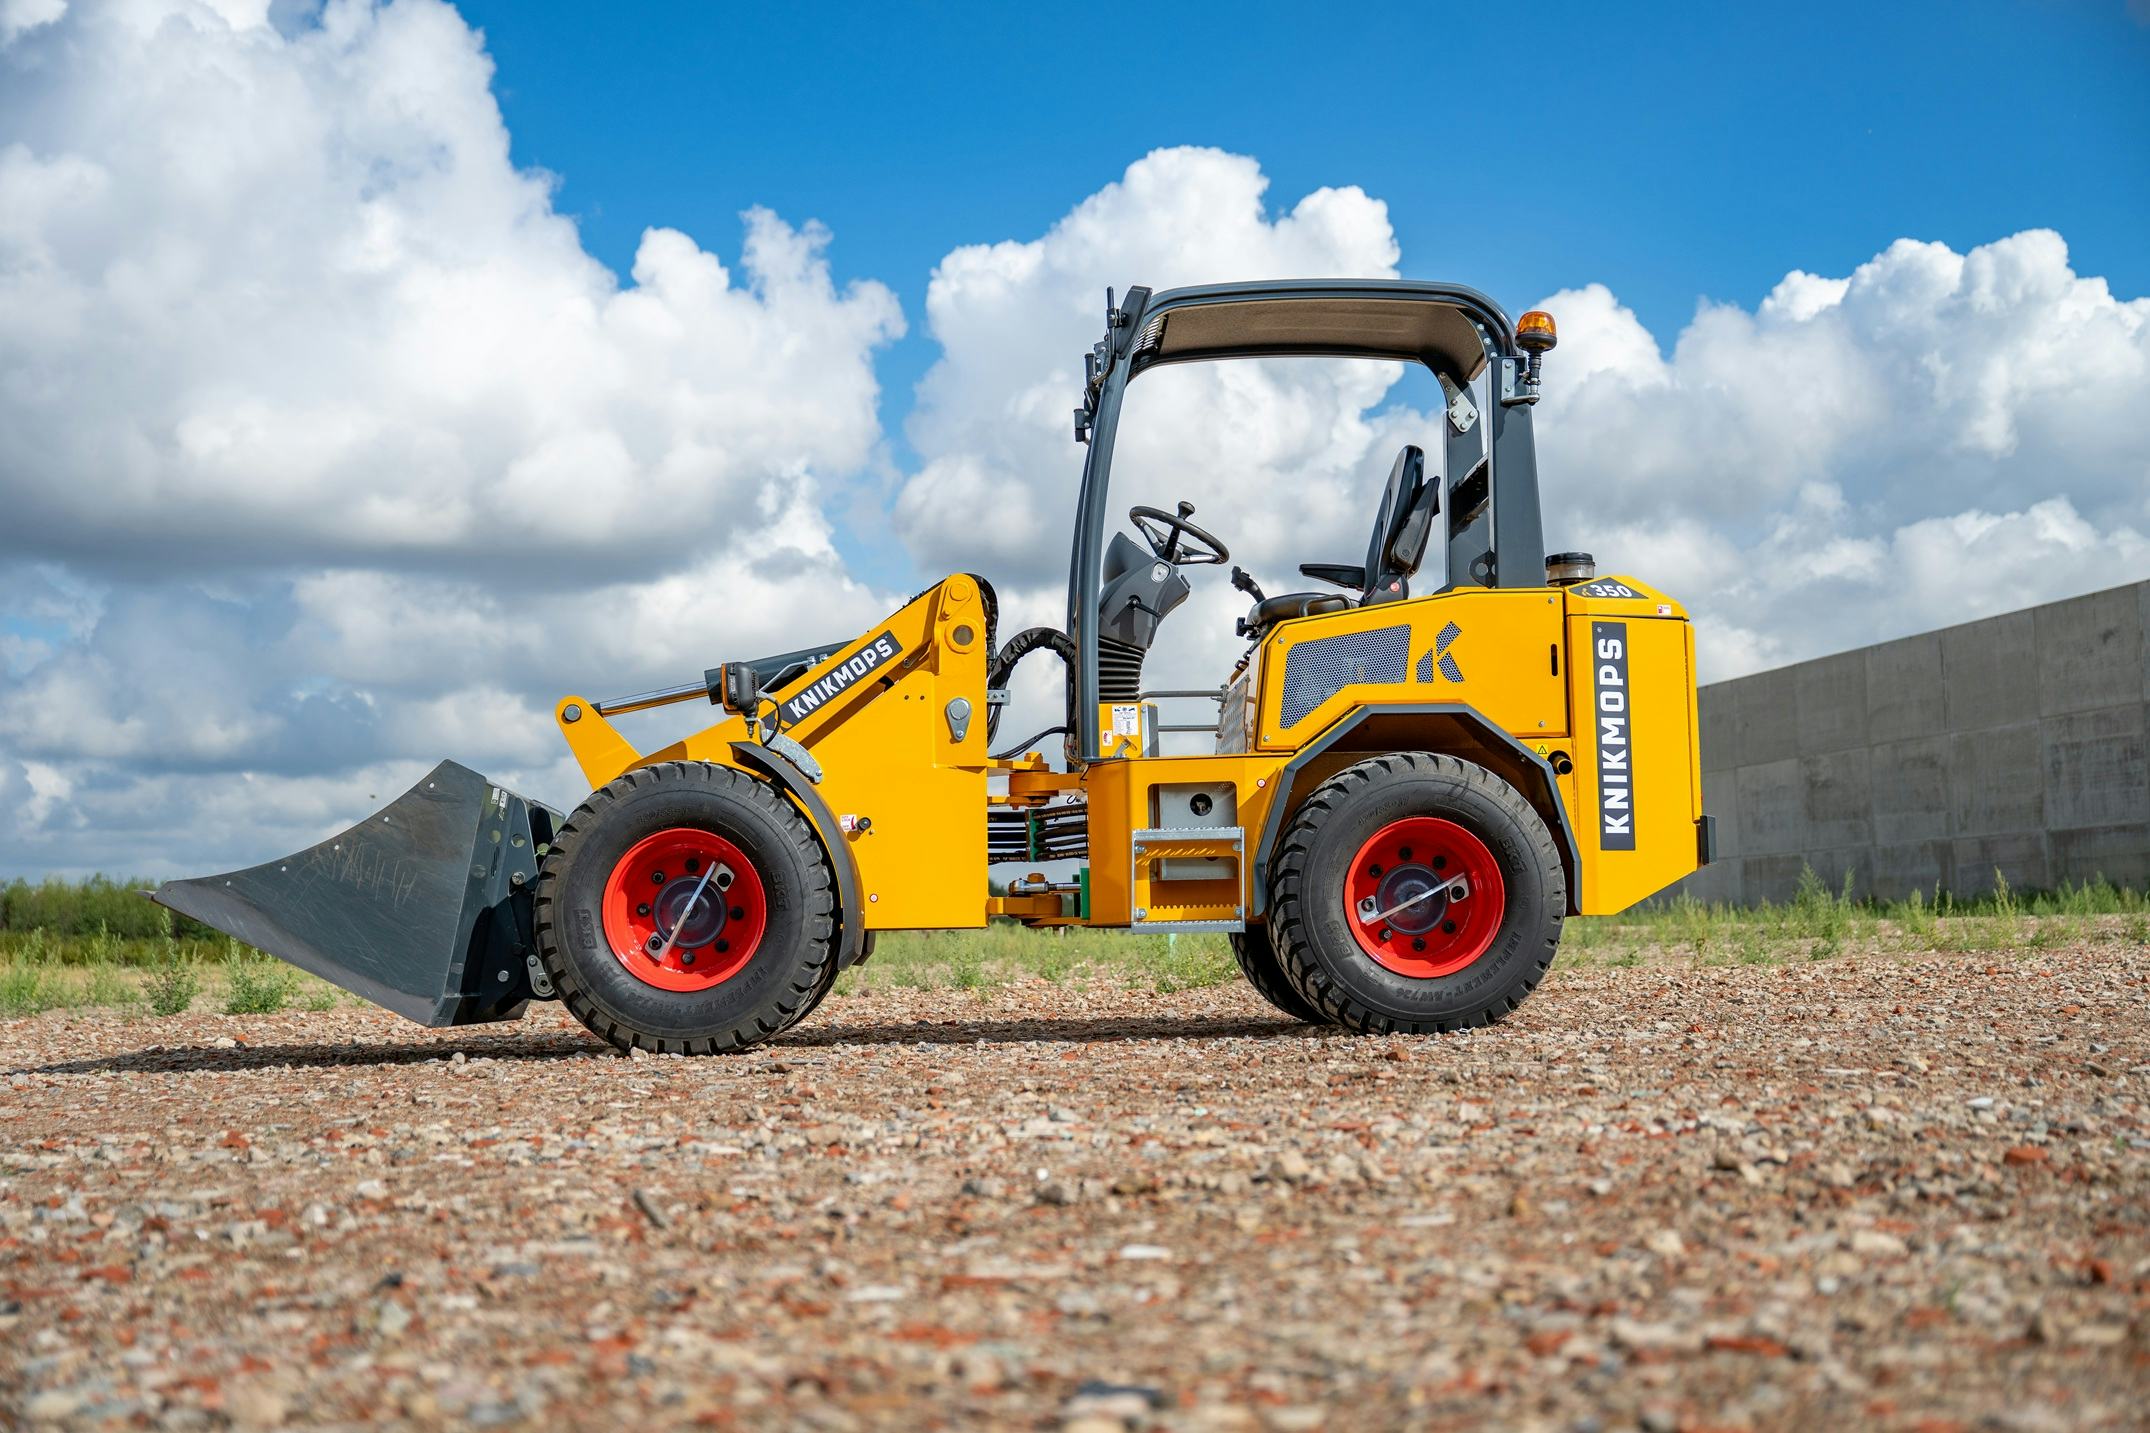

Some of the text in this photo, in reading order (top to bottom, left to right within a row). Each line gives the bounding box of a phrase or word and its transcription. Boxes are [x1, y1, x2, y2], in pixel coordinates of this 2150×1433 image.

[1590, 584, 1633, 598] 350
[790, 640, 893, 718] KNIKMOPS
[1598, 638, 1630, 834] KNIKMOPS
